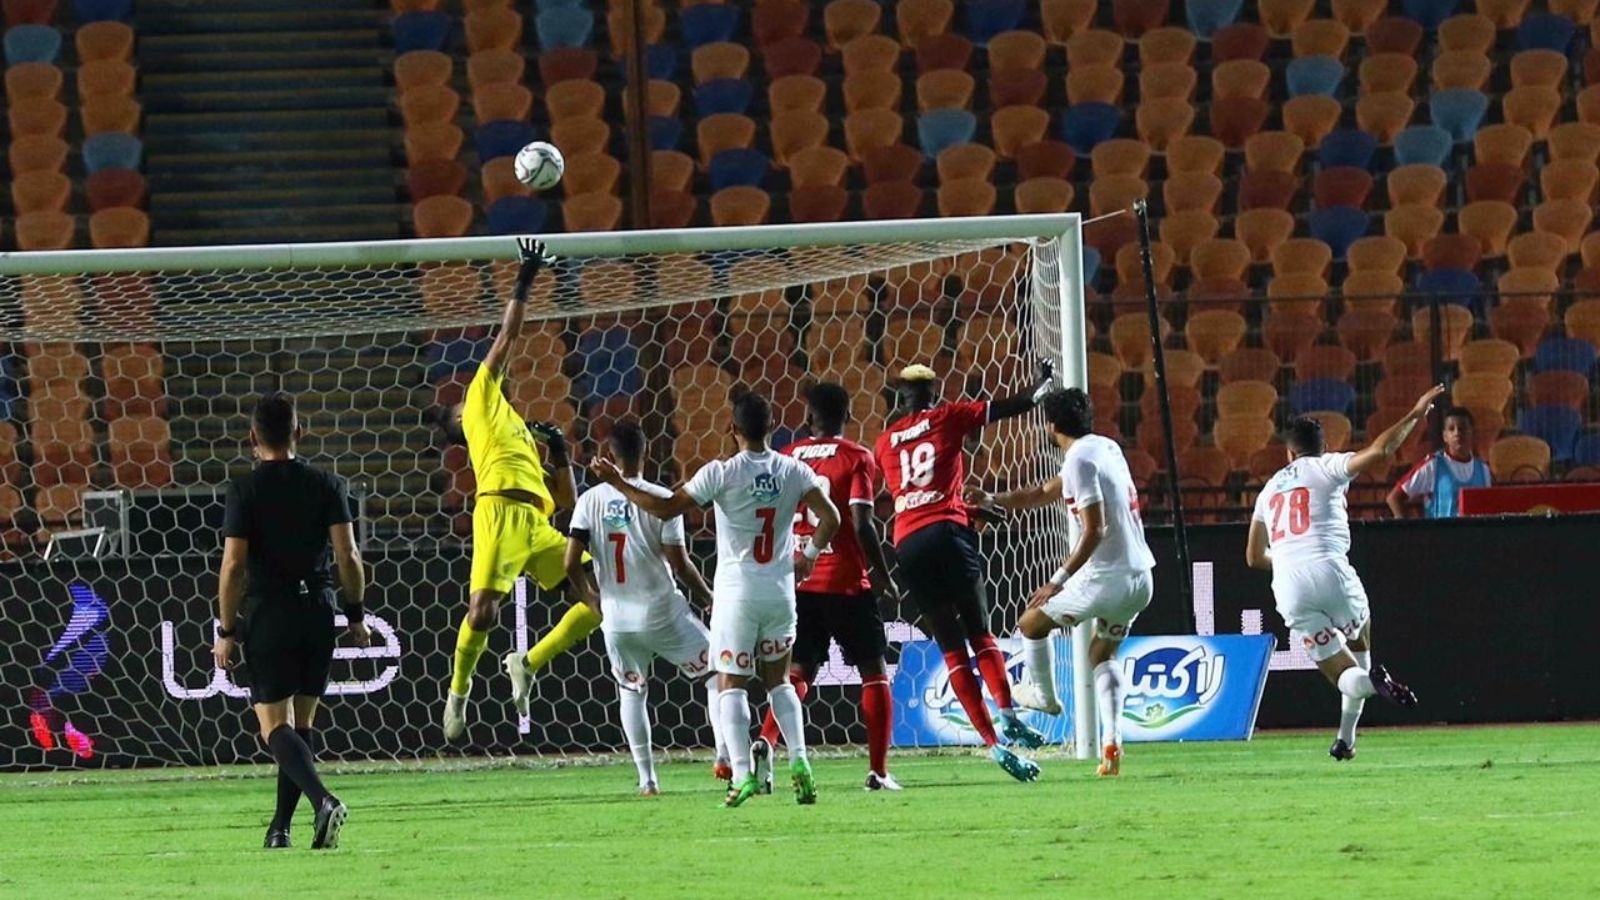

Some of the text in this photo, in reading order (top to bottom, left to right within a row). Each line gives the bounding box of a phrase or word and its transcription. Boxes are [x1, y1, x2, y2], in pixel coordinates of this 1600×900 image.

[792, 443, 839, 460] TIGER
[900, 442, 935, 489] 18
[753, 507, 776, 565] 3
[1269, 487, 1311, 543] 28
[608, 533, 627, 584] 7
